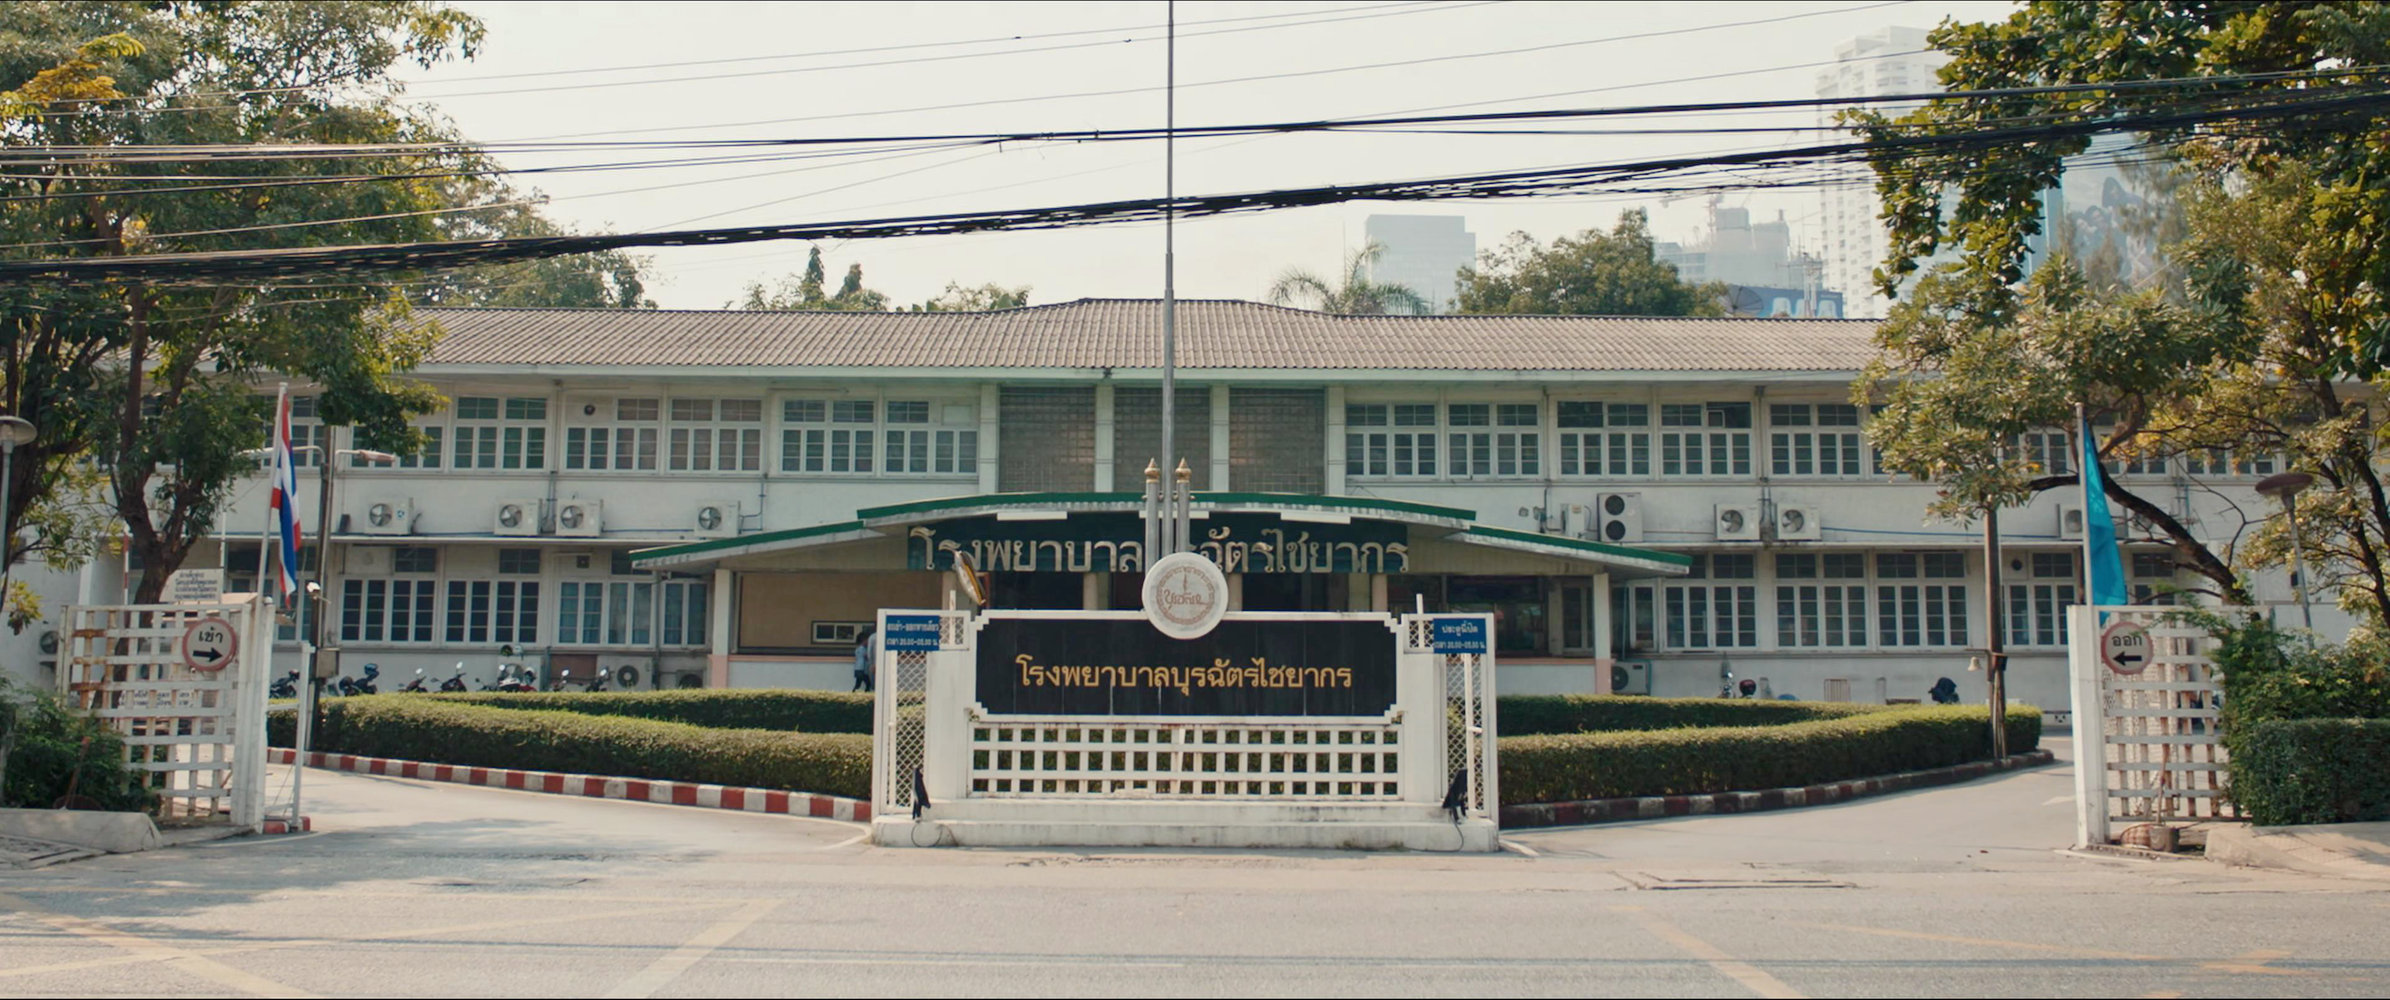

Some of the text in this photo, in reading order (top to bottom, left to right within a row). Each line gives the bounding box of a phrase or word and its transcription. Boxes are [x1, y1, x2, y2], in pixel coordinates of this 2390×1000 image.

[909, 525, 1409, 574] โรงพยาบาลฉัตรไชยากร
[198, 625, 224, 644] เข้า
[2111, 635, 2143, 647] ออก
[1015, 653, 1353, 697] โรงพยาบาลบุรฉัตรไชยากร
